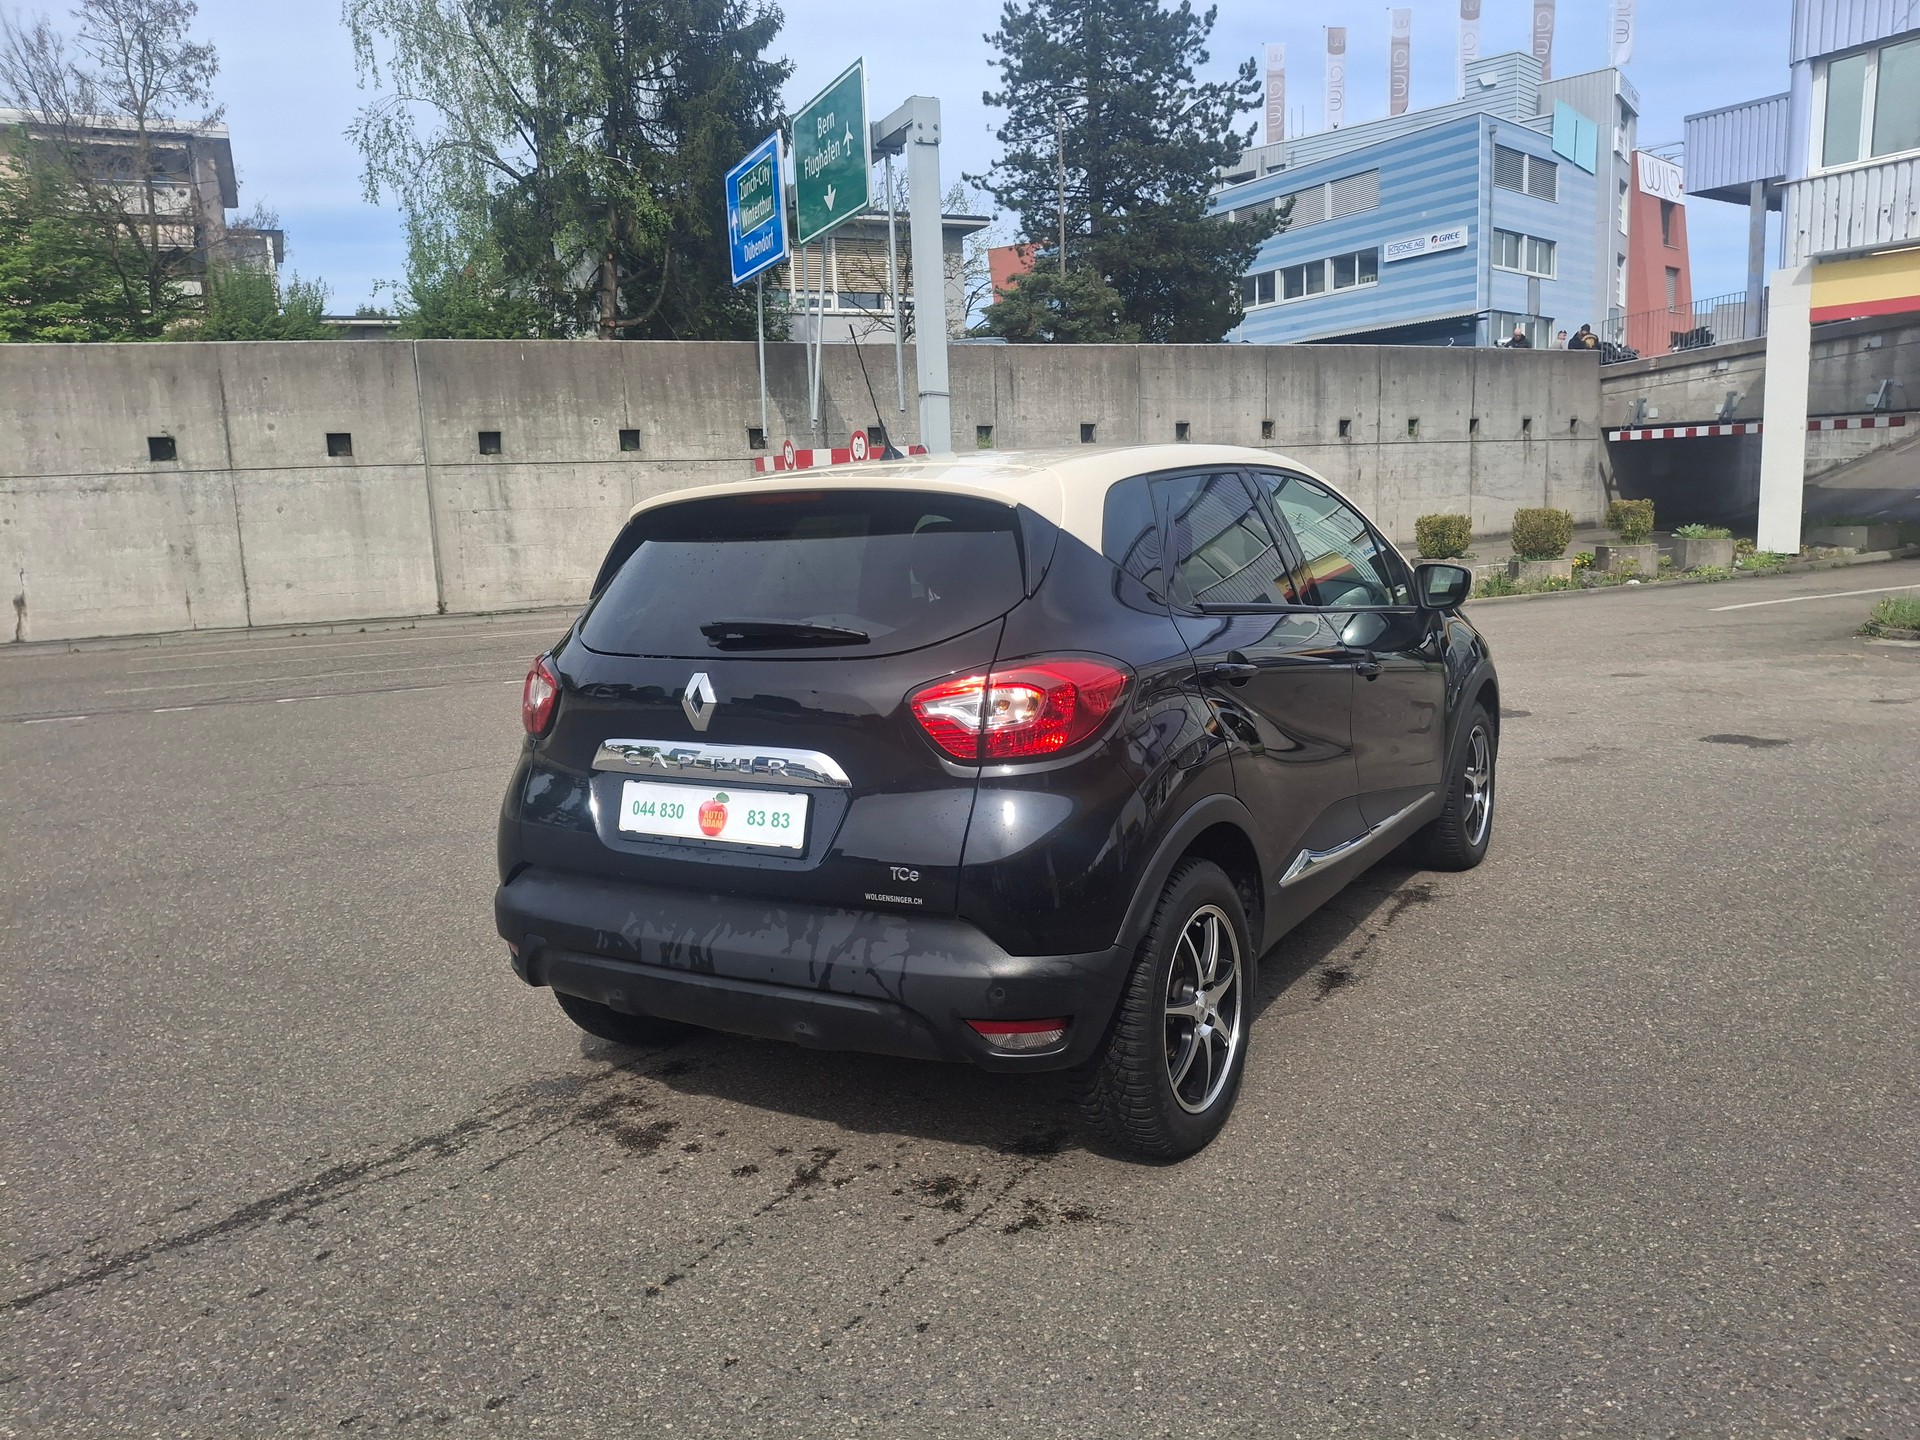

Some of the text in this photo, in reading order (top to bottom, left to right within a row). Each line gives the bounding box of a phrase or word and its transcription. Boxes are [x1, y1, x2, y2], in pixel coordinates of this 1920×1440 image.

[817, 112, 835, 139] Bern
[804, 139, 841, 180] Flughafen
[740, 164, 771, 201] Zürich-City
[741, 194, 772, 229] Winterthur
[743, 226, 774, 263] Dübendorf
[1388, 243, 1413, 255] KRONE
[1413, 240, 1424, 249] AG
[1439, 230, 1461, 243] GREE
[623, 750, 789, 777] CAPTUR
[632, 800, 791, 829] 044 830 83 83
[701, 819, 723, 830] ADAM
[704, 810, 724, 821] AUTO
[889, 866, 920, 882] TCe
[864, 892, 923, 906] WOLGENSINGER.CH
